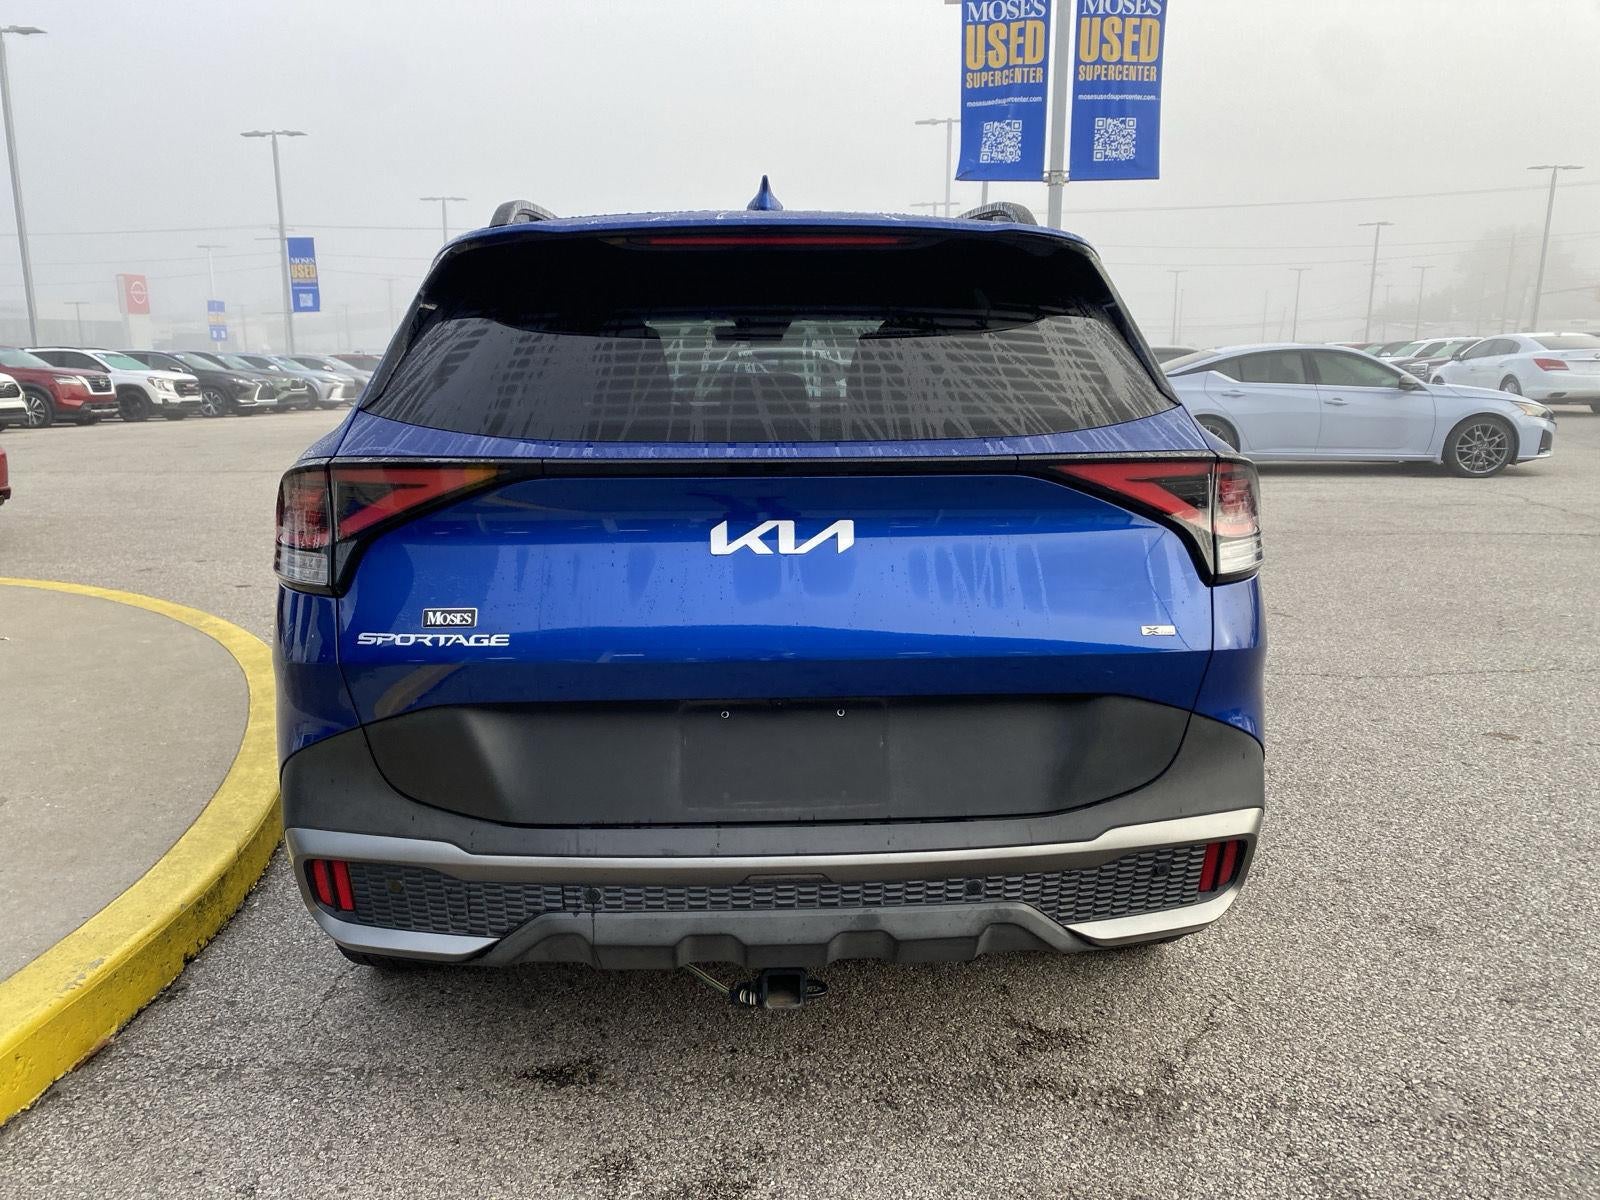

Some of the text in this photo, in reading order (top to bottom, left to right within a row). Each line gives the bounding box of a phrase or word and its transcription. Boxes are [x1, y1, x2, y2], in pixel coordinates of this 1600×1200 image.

[967, 0, 1046, 22] MOSES
[1082, 0, 1161, 15] MOSES
[966, 21, 1045, 70] USED
[1079, 17, 1160, 63] USED
[966, 67, 1043, 89] SUPERCENTER
[1078, 65, 1157, 82] SUPERCENTER
[966, 96, 1042, 108] mosesusedsupercenter.com
[1077, 93, 1156, 101] mosesusedsupercenter.com
[291, 264, 317, 278] USED
[710, 520, 854, 555] KIA
[357, 632, 510, 647] SPORTAGE
